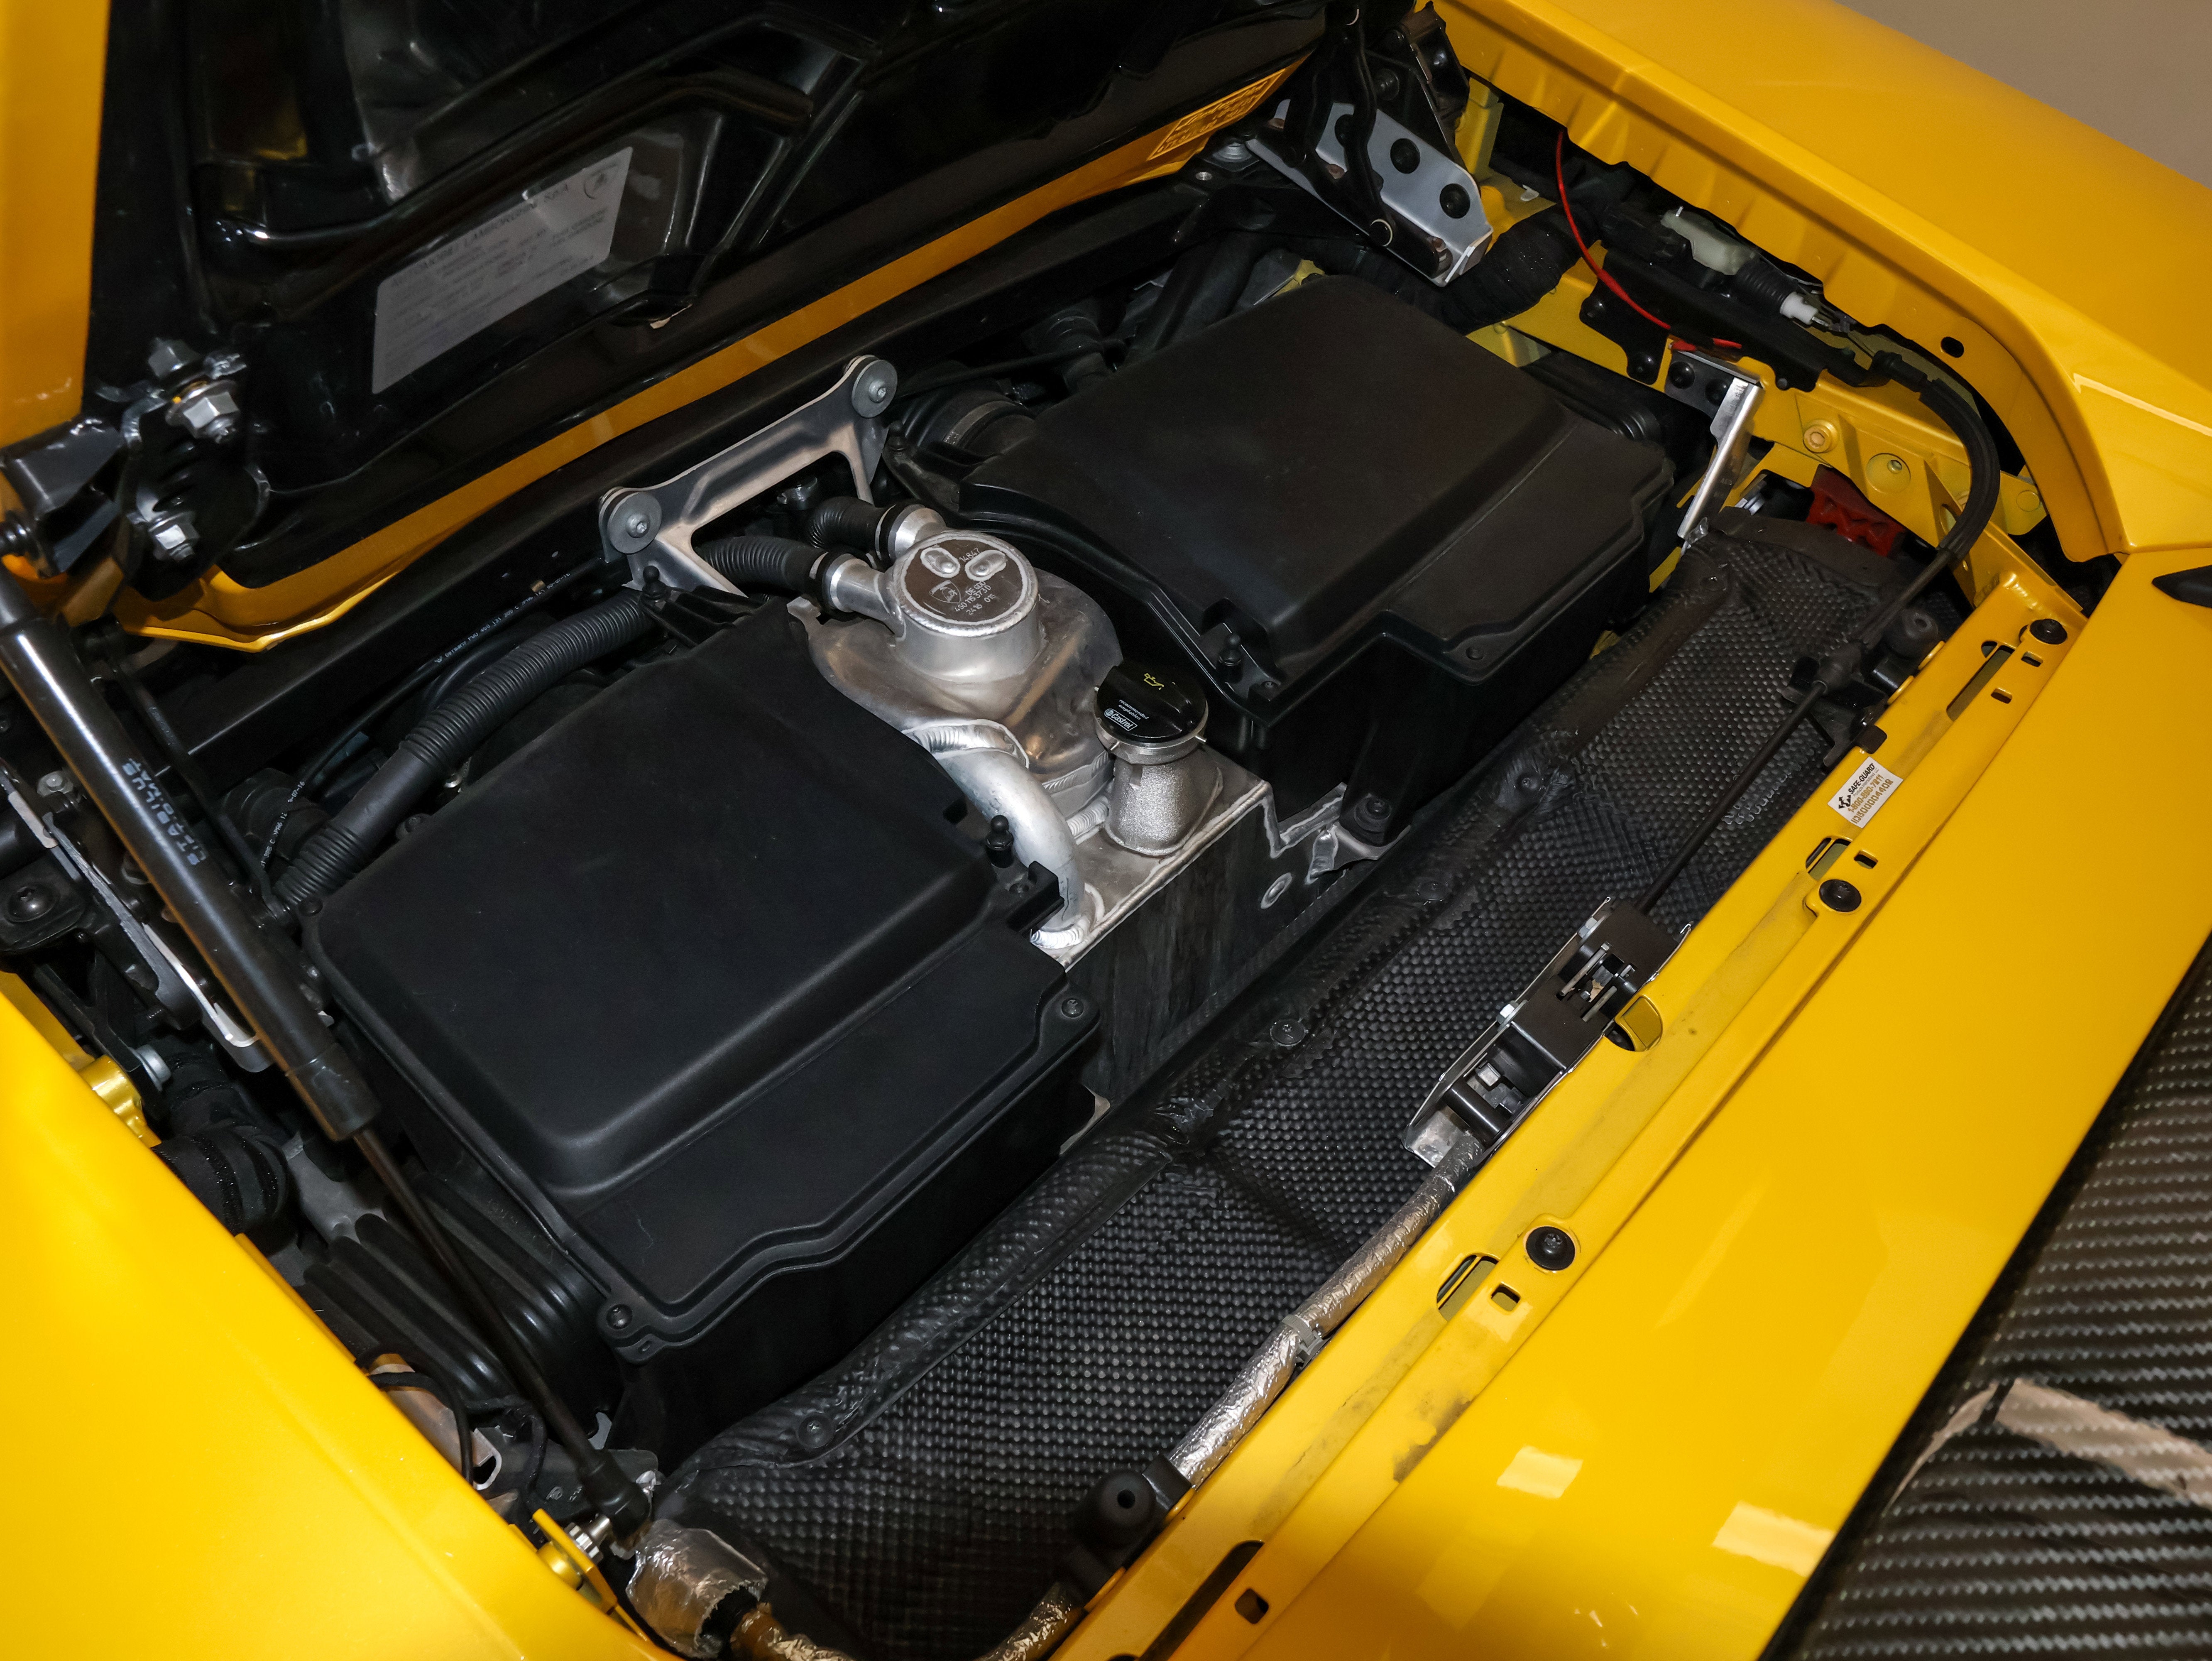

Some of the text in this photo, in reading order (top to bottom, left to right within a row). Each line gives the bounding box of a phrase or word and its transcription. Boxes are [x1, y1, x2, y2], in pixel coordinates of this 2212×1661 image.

[959, 547, 981, 562] 14847
[1118, 699, 1149, 719] recommended
[1118, 705, 1141, 720] empfohlen
[1111, 713, 1133, 729] Castrol
[1848, 764, 1875, 794] SAFE-GUARD
